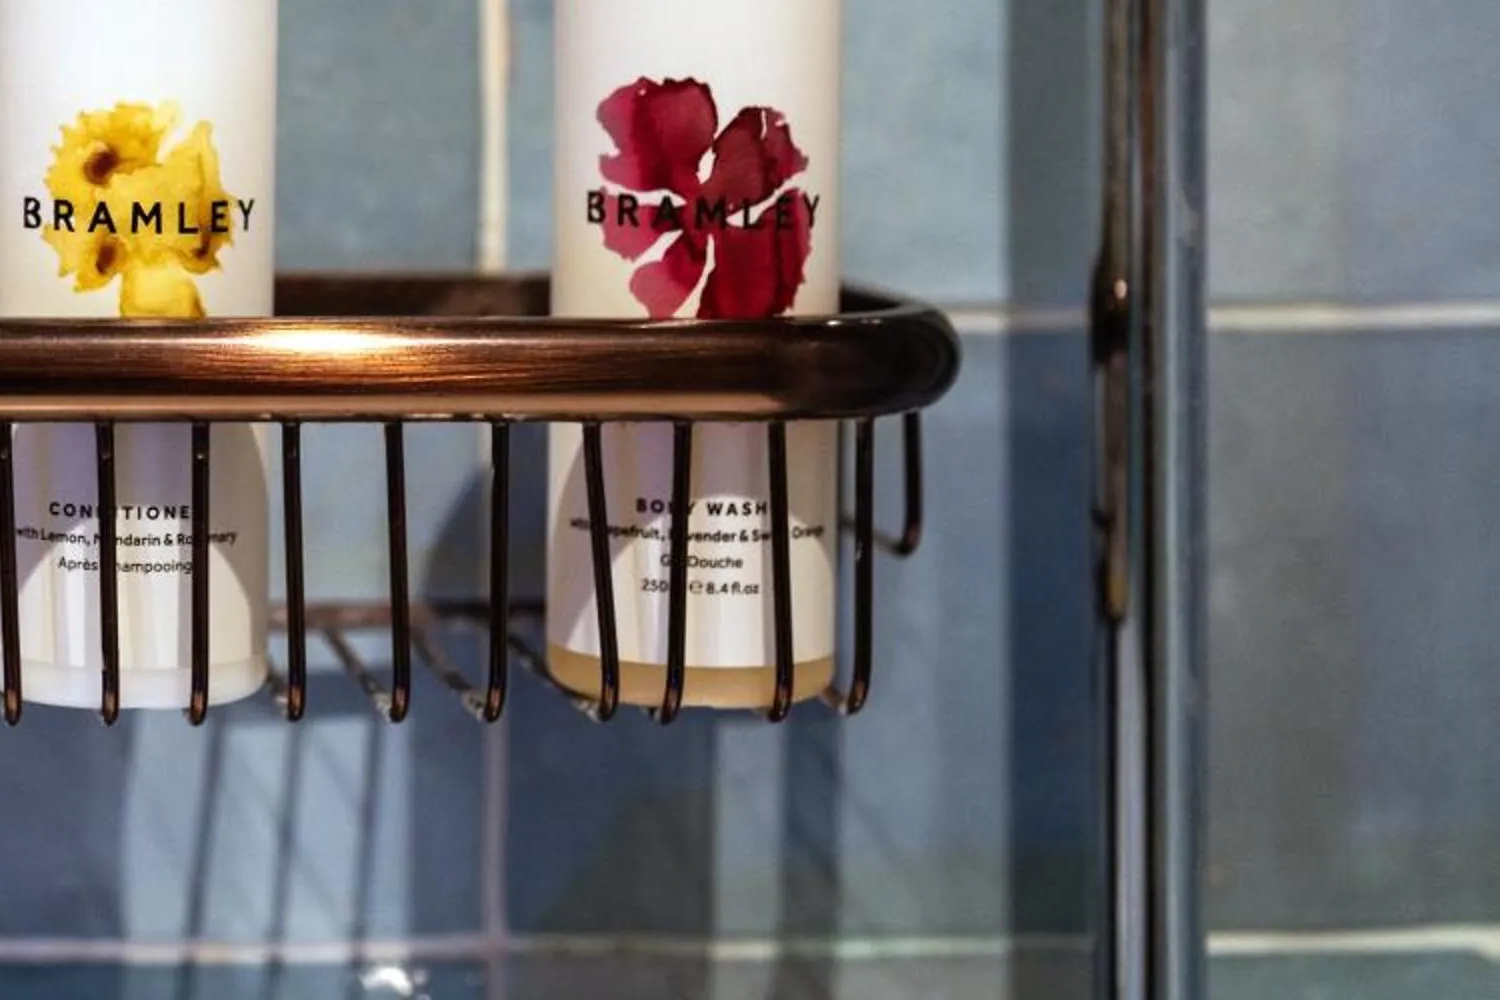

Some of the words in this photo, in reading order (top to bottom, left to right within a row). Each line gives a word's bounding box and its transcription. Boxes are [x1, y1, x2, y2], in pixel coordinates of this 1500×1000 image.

[23, 197, 255, 234] BRAMLEY
[586, 190, 820, 230] BRAMLEY
[49, 502, 190, 520] CONTIONE
[636, 498, 696, 515] BOY
[706, 502, 768, 516] WASH
[40, 528, 91, 546] Lemon,
[93, 533, 161, 547] Mndarin
[163, 533, 173, 546] &
[176, 531, 238, 547] Romary
[684, 530, 737, 543] vender
[739, 530, 749, 542] &
[115, 560, 192, 574] hampooing
[642, 578, 670, 593] 250
[705, 581, 729, 595] 8.4
